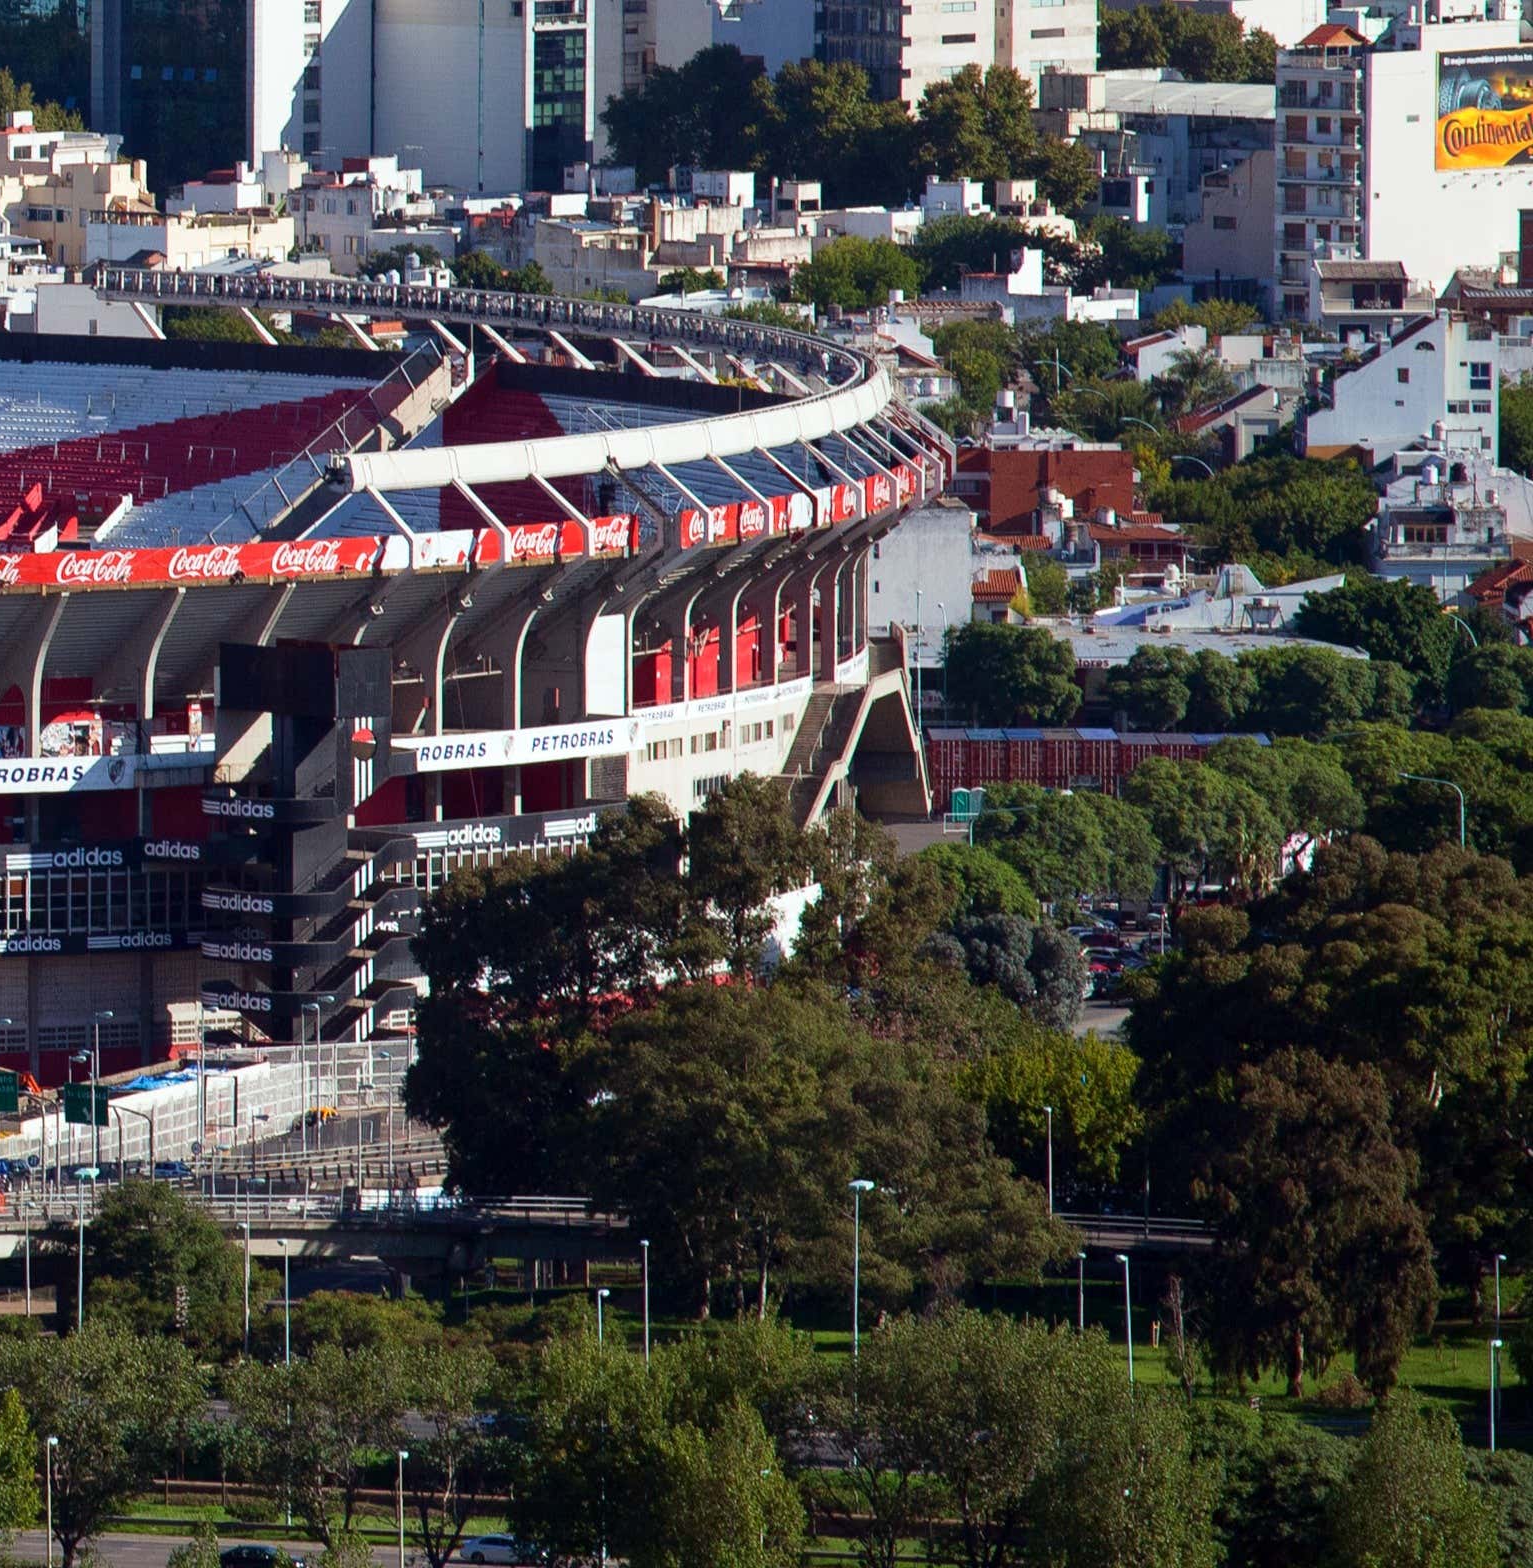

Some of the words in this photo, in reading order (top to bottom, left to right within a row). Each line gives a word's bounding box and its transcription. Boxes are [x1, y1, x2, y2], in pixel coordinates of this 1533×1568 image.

[168, 545, 245, 578] Coca-Cola
[271, 540, 342, 573] Coca-Cola
[55, 551, 137, 583] Coca-Cola
[532, 729, 614, 752] PETROBRAS
[220, 799, 275, 819] adidas
[448, 823, 501, 845] adidas
[53, 847, 123, 868] adidas
[144, 841, 201, 860] adidas
[220, 893, 274, 913] adidas
[6, 935, 62, 953] adidas
[120, 930, 172, 947] adidas
[219, 943, 273, 962] adidas
[218, 991, 271, 1011] adidas
